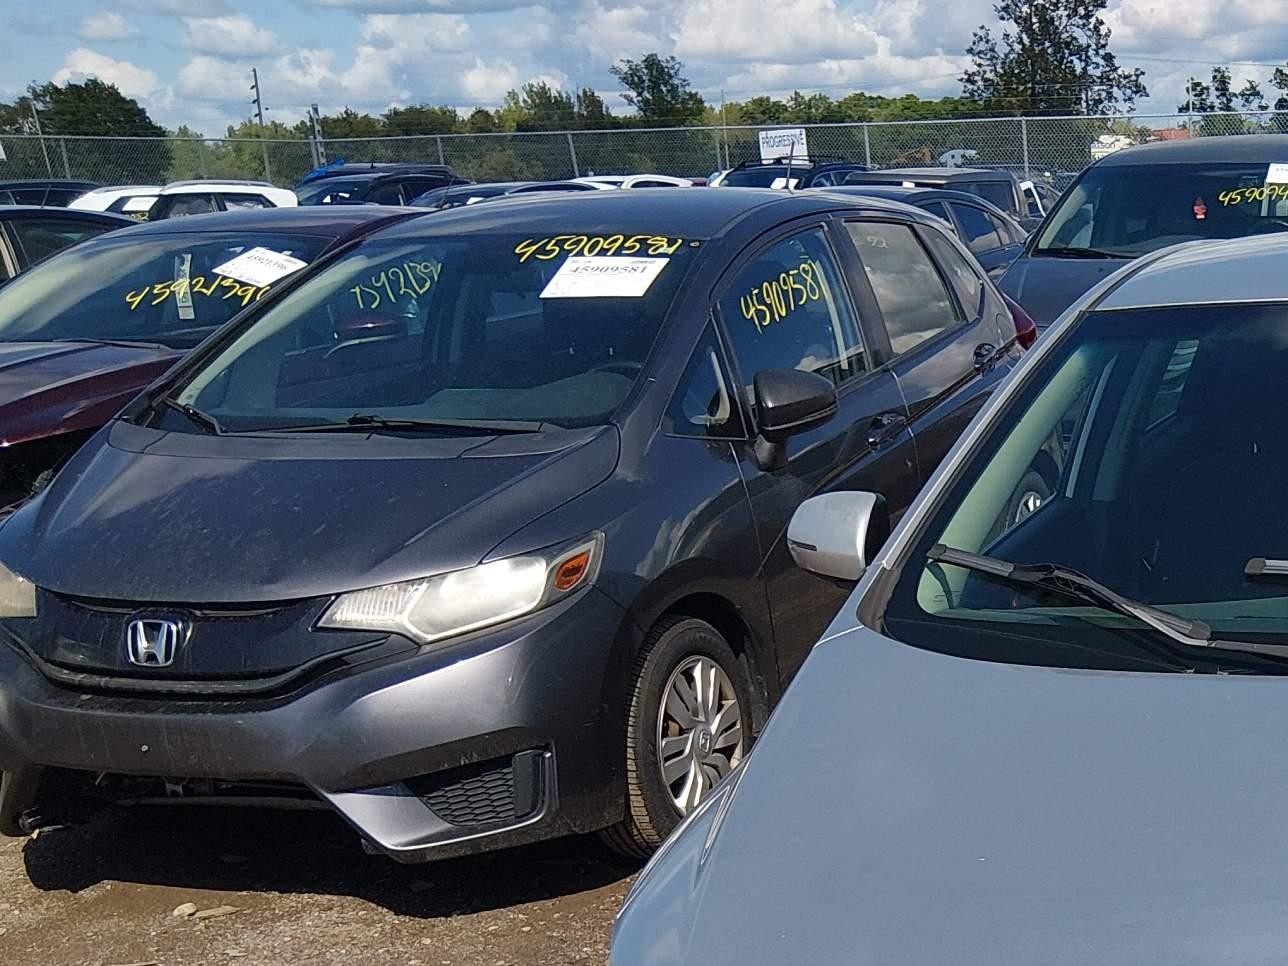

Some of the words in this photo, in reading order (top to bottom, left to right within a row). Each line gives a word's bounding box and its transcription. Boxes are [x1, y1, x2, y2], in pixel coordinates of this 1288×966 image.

[514, 234, 683, 263] 45909581
[569, 265, 648, 274] 45909581
[740, 259, 827, 334] 45909581
